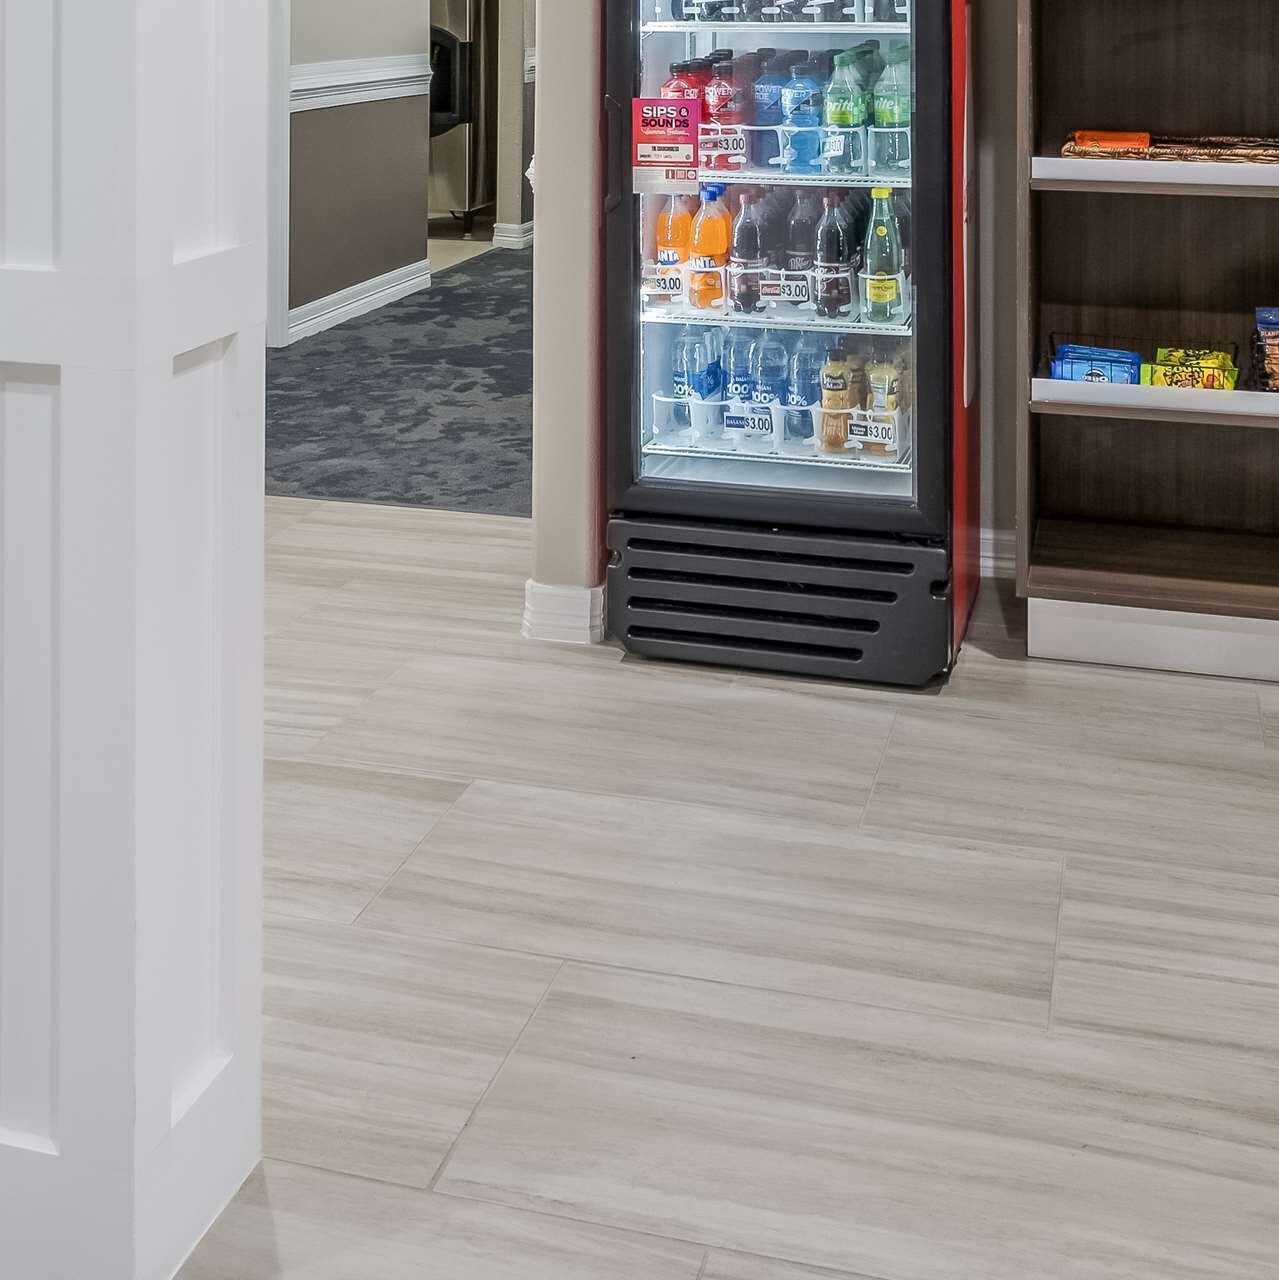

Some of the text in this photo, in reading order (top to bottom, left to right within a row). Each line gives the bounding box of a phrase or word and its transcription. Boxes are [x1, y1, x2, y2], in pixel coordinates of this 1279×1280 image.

[642, 106, 688, 118] SIPS &
[641, 118, 690, 128] SOUNDS
[718, 137, 745, 151] $3.00
[657, 277, 681, 290] $3.00
[781, 283, 807, 298] $3.00
[745, 417, 770, 432] $3.00
[869, 425, 893, 441] $3.00
